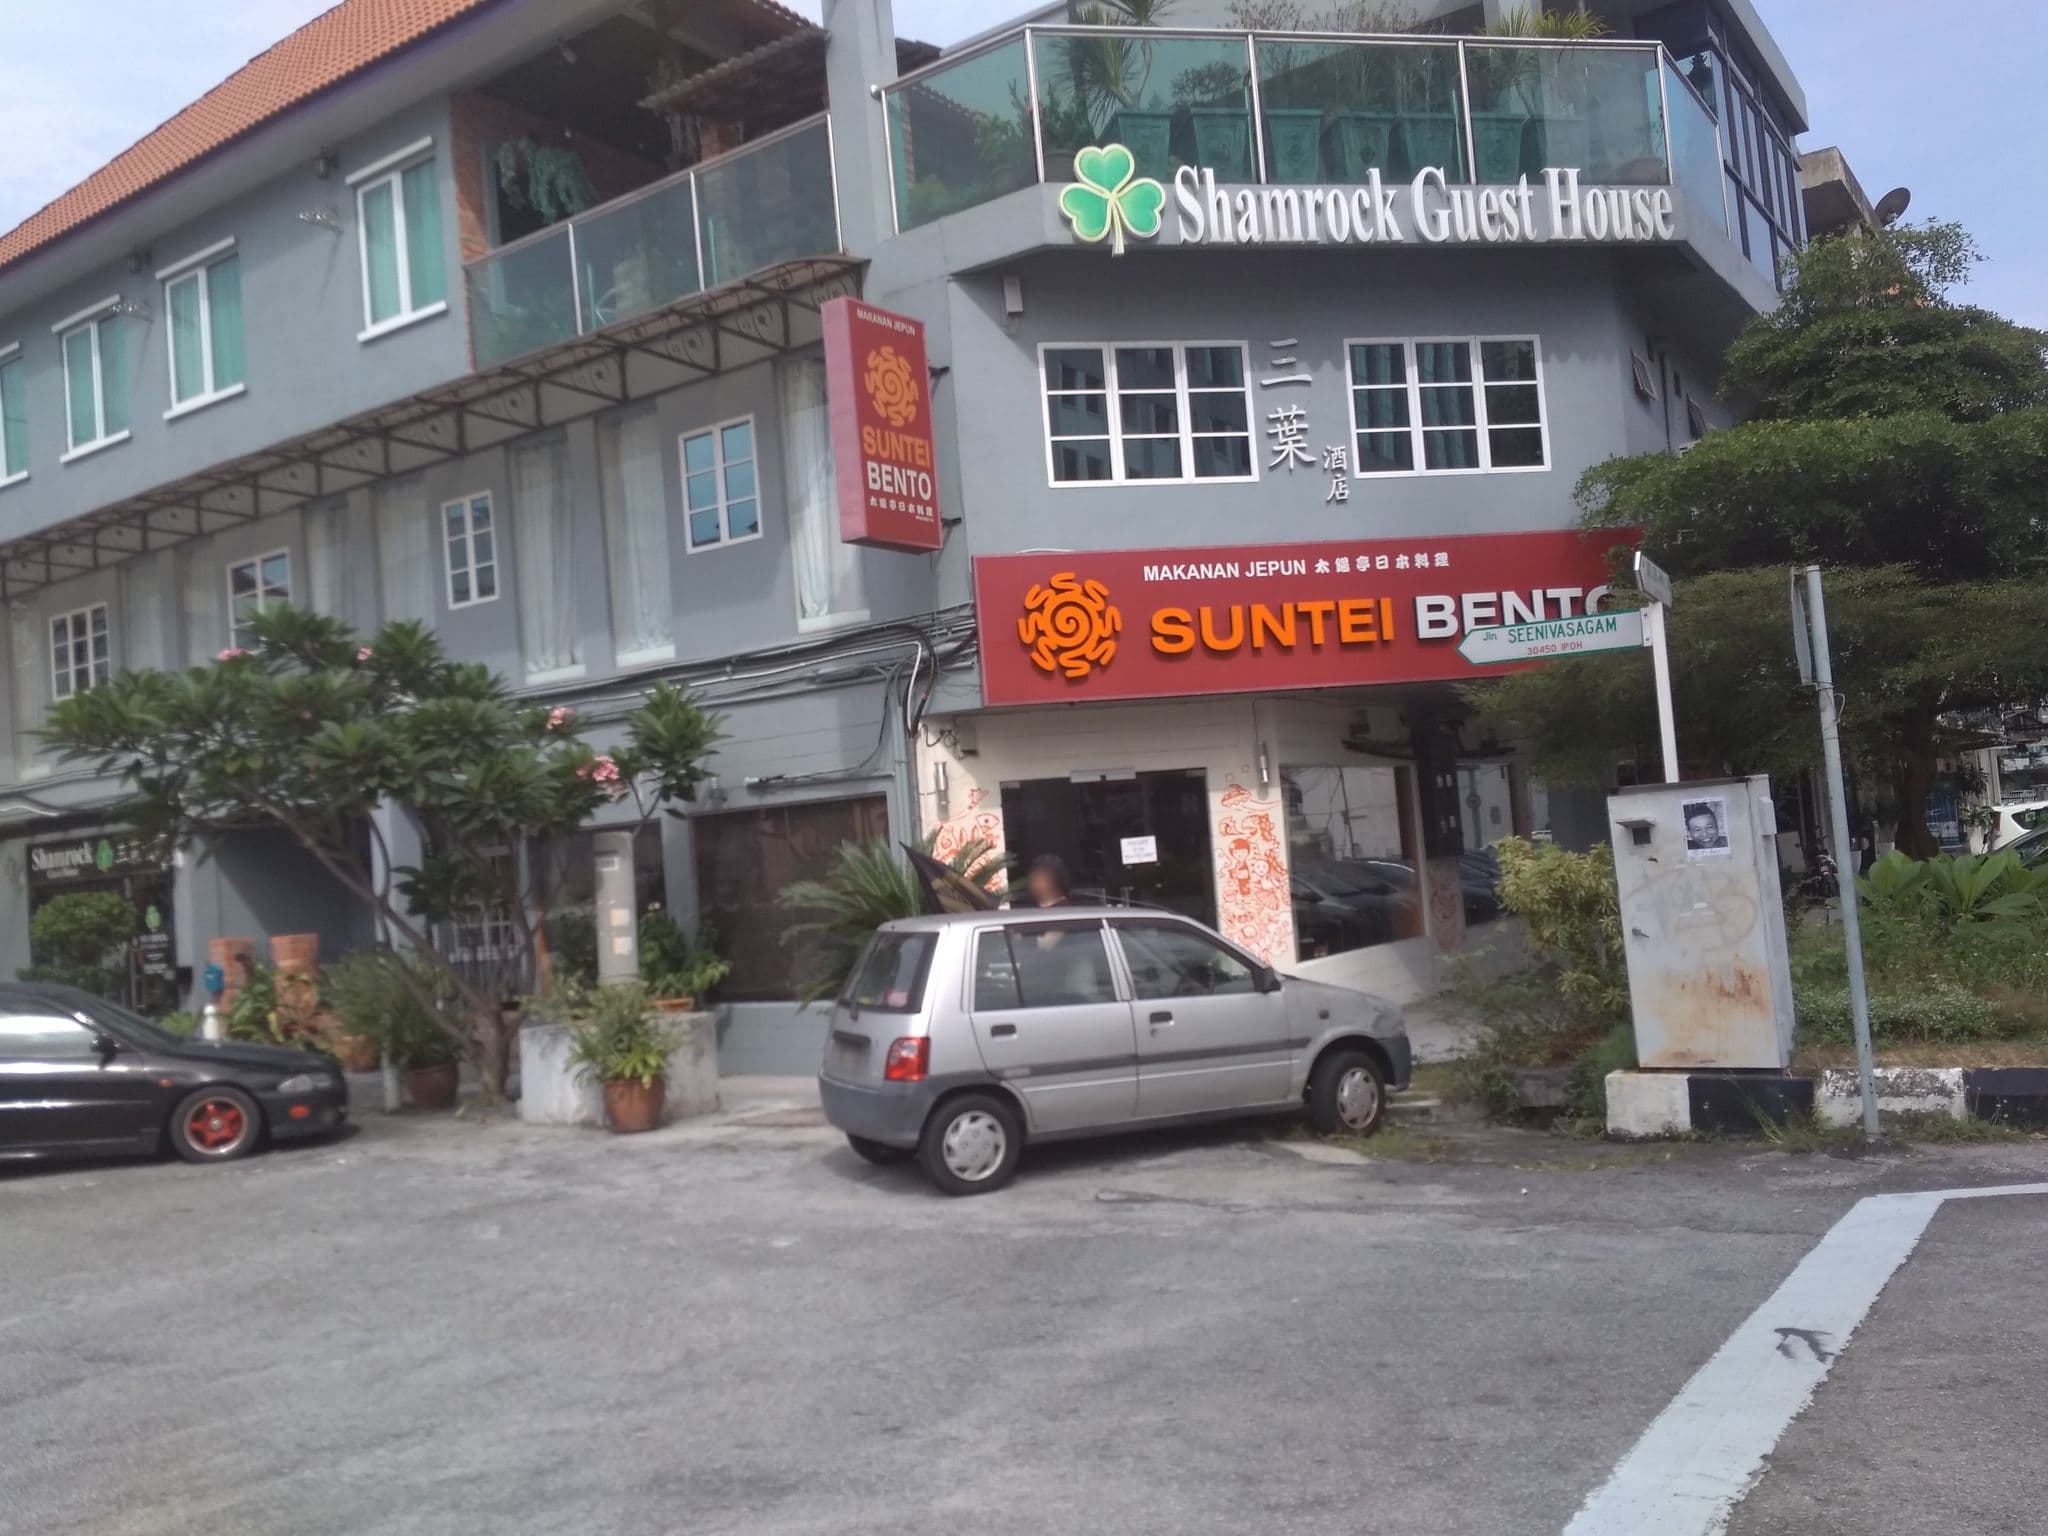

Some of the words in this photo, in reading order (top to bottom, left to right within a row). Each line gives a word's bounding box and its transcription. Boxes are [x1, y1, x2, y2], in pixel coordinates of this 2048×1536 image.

[1174, 165, 1404, 244] Shamrock
[1410, 166, 1537, 243] Guest
[1540, 168, 1675, 242] House
[857, 308, 893, 328] MAKANAN
[1260, 338, 1317, 472] 三葉
[862, 425, 930, 469] SUNTEI
[867, 461, 932, 501] BENTO
[1322, 445, 1350, 502] 酒店
[1144, 562, 1240, 581] MAKANAN
[1245, 559, 1307, 577] JEPUN
[1151, 597, 1394, 653] SUNTEI
[1508, 617, 1618, 644] SEENIVASAGAM
[1527, 644, 1557, 656] 30450
[1561, 641, 1583, 652] IPOH
